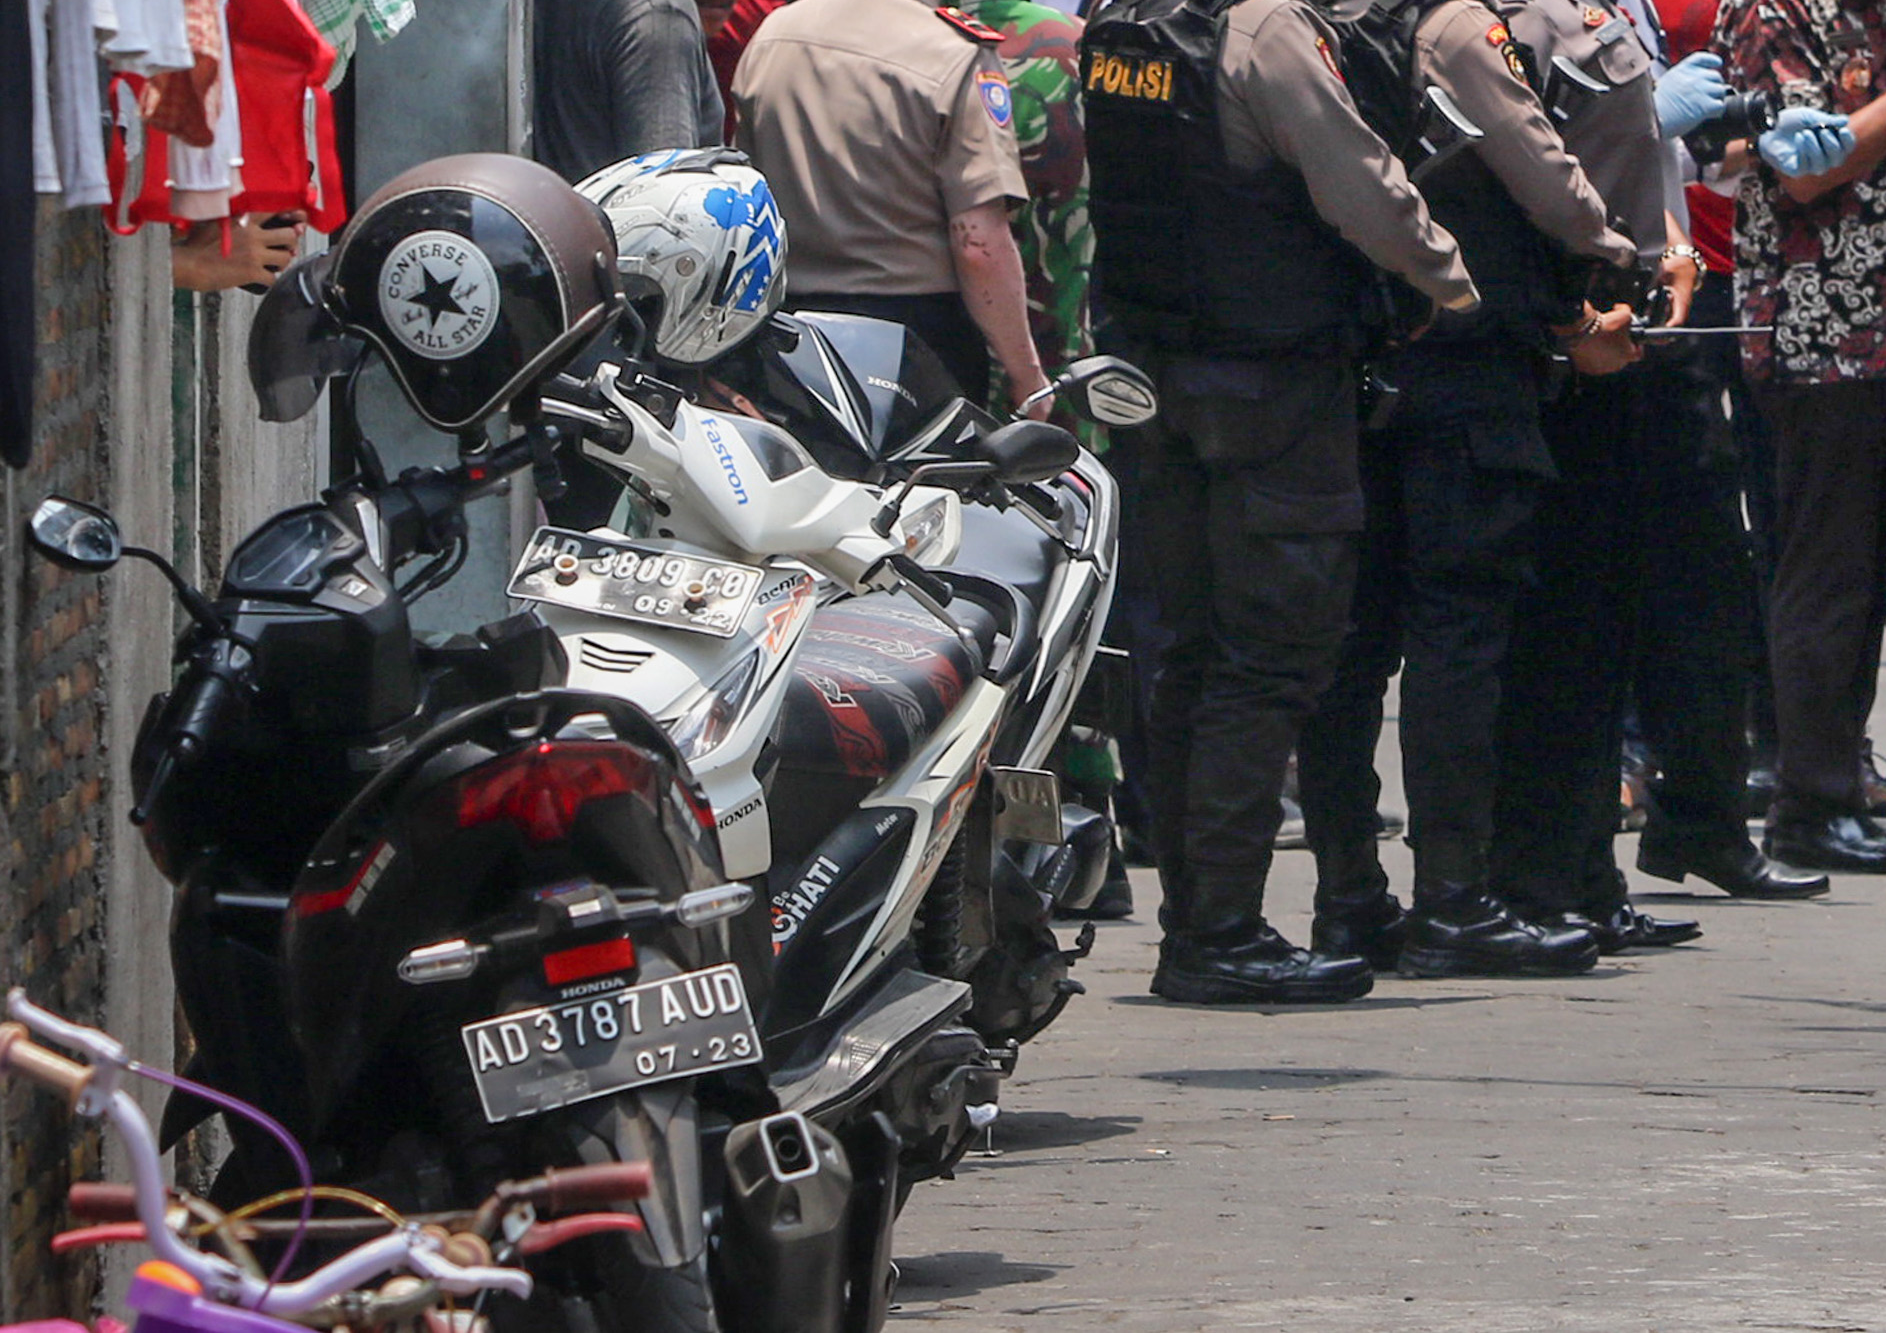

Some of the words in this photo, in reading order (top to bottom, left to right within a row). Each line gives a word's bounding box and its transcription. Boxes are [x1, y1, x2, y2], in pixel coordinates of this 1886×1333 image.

[1087, 51, 1173, 101] POLISI
[388, 243, 468, 299] CONVERSE
[413, 330, 448, 348] ALL
[452, 306, 486, 345] STAR
[866, 375, 919, 408] HONDA
[701, 418, 749, 505] Fastron
[590, 547, 687, 588] 3809
[717, 797, 763, 830] HONDA
[786, 855, 841, 920] HATI
[560, 976, 626, 1000] HONDA
[477, 1022, 530, 1072] AD
[534, 992, 644, 1053] 3787
[660, 971, 744, 1026] AUD
